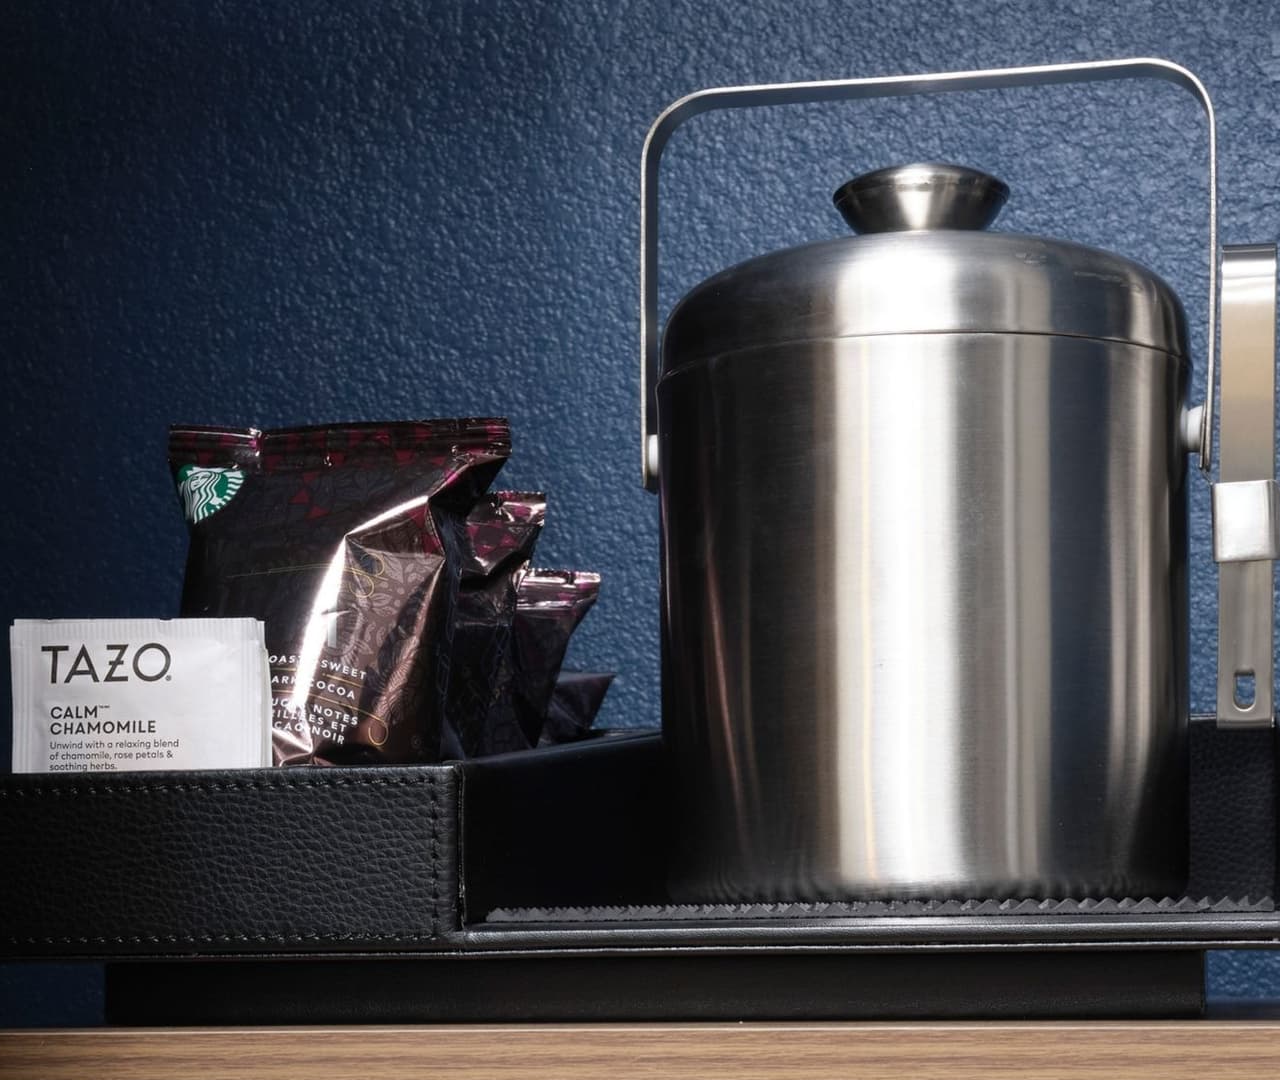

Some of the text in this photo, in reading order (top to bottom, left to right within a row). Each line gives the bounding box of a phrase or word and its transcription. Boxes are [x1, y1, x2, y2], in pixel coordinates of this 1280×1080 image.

[320, 659, 367, 680] SWEET
[313, 704, 359, 726] NOTES
[50, 720, 156, 735] CHAMOMILE
[331, 721, 347, 733] ET
[311, 725, 346, 745] NOIR
[49, 741, 83, 750] Unwind
[85, 740, 106, 749] with
[115, 739, 151, 750] relaxing
[153, 738, 179, 748] blend
[49, 752, 59, 760] of
[60, 751, 112, 760] chamomile,
[135, 750, 164, 760] petals
[166, 750, 173, 758] &
[49, 760, 117, 771] soothing herbs.
